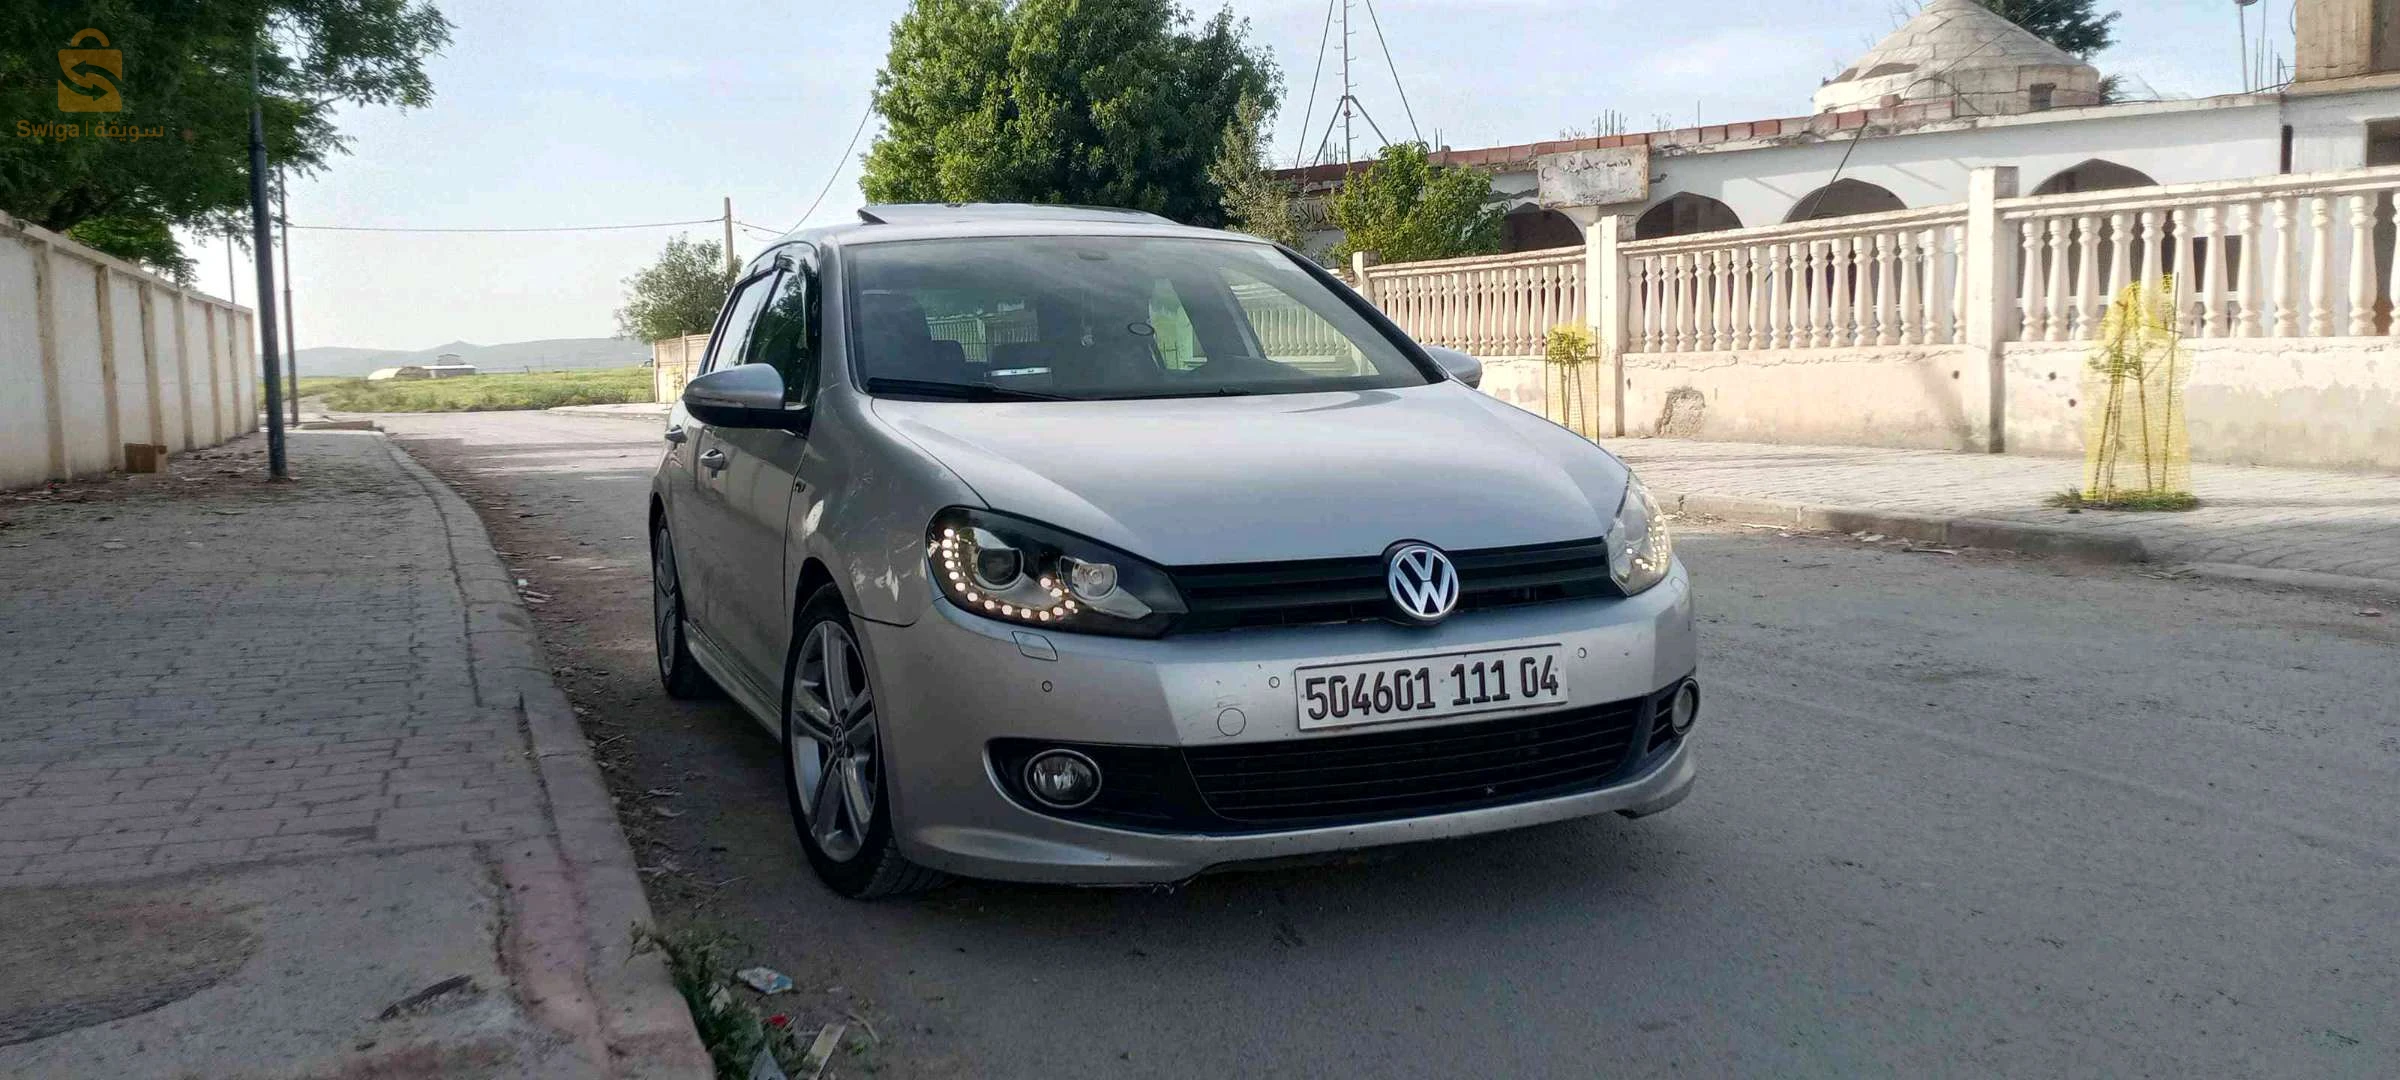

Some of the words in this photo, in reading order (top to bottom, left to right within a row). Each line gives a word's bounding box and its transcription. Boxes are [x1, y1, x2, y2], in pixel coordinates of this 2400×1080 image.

[1390, 547, 1457, 616] VW
[1305, 667, 1436, 720] 504601
[1450, 659, 1510, 706] 111
[1520, 655, 1559, 698] 04
